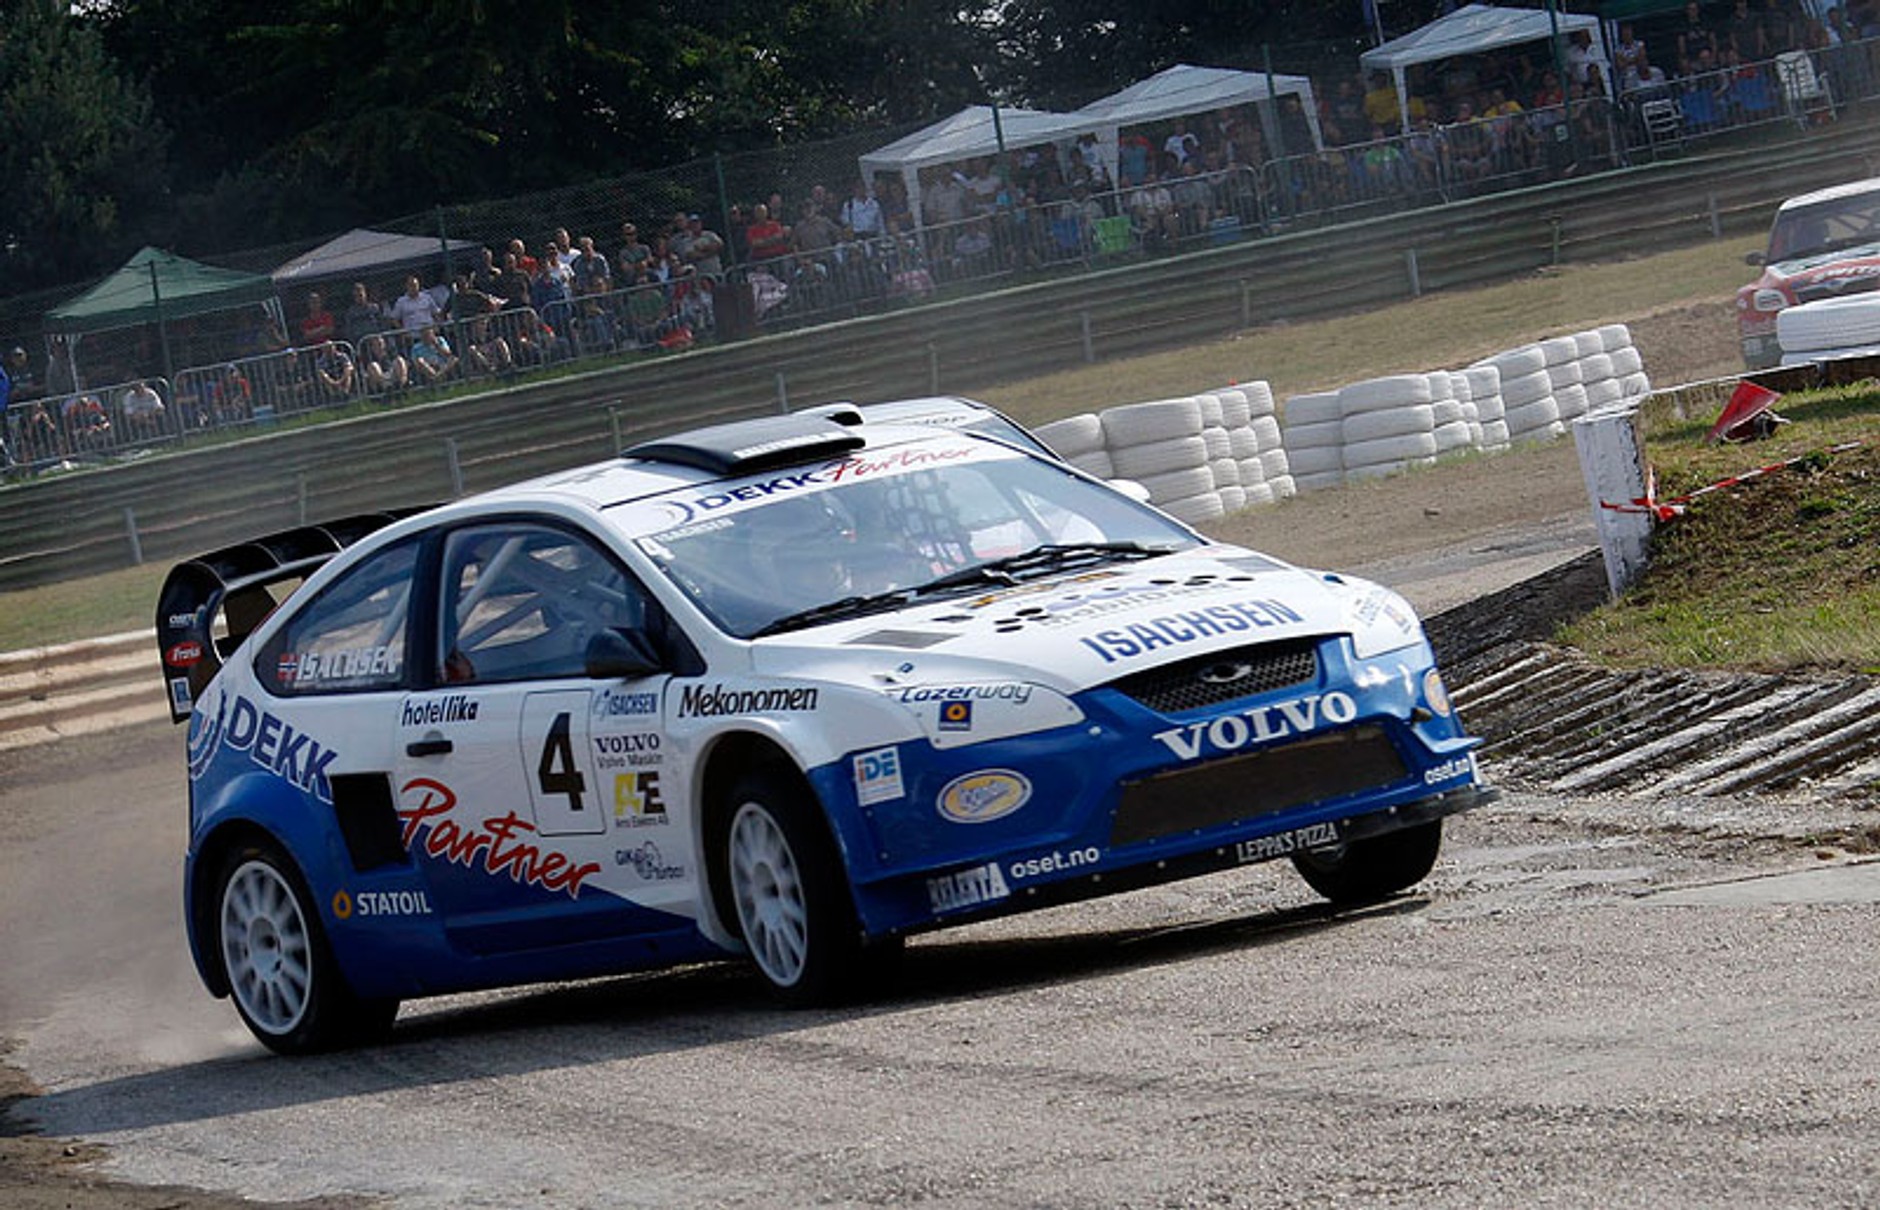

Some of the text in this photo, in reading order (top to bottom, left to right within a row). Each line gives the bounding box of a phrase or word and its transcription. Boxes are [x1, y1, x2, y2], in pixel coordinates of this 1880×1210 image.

[696, 446, 978, 511] DEKK Partner
[638, 537, 676, 560] 4
[1080, 599, 1304, 663] ISACHSEN
[296, 646, 398, 681] ISACHSEN
[677, 683, 818, 718] Mekonomen
[595, 733, 660, 753] VOLVO
[1152, 691, 1357, 760] VOLVO
[227, 695, 338, 804] DEKK
[538, 712, 587, 811] 4
[396, 777, 602, 897] Partner
[1295, 822, 1338, 849] PIZZA
[1010, 847, 1099, 878] oset.no
[357, 891, 432, 916] STATOIL
